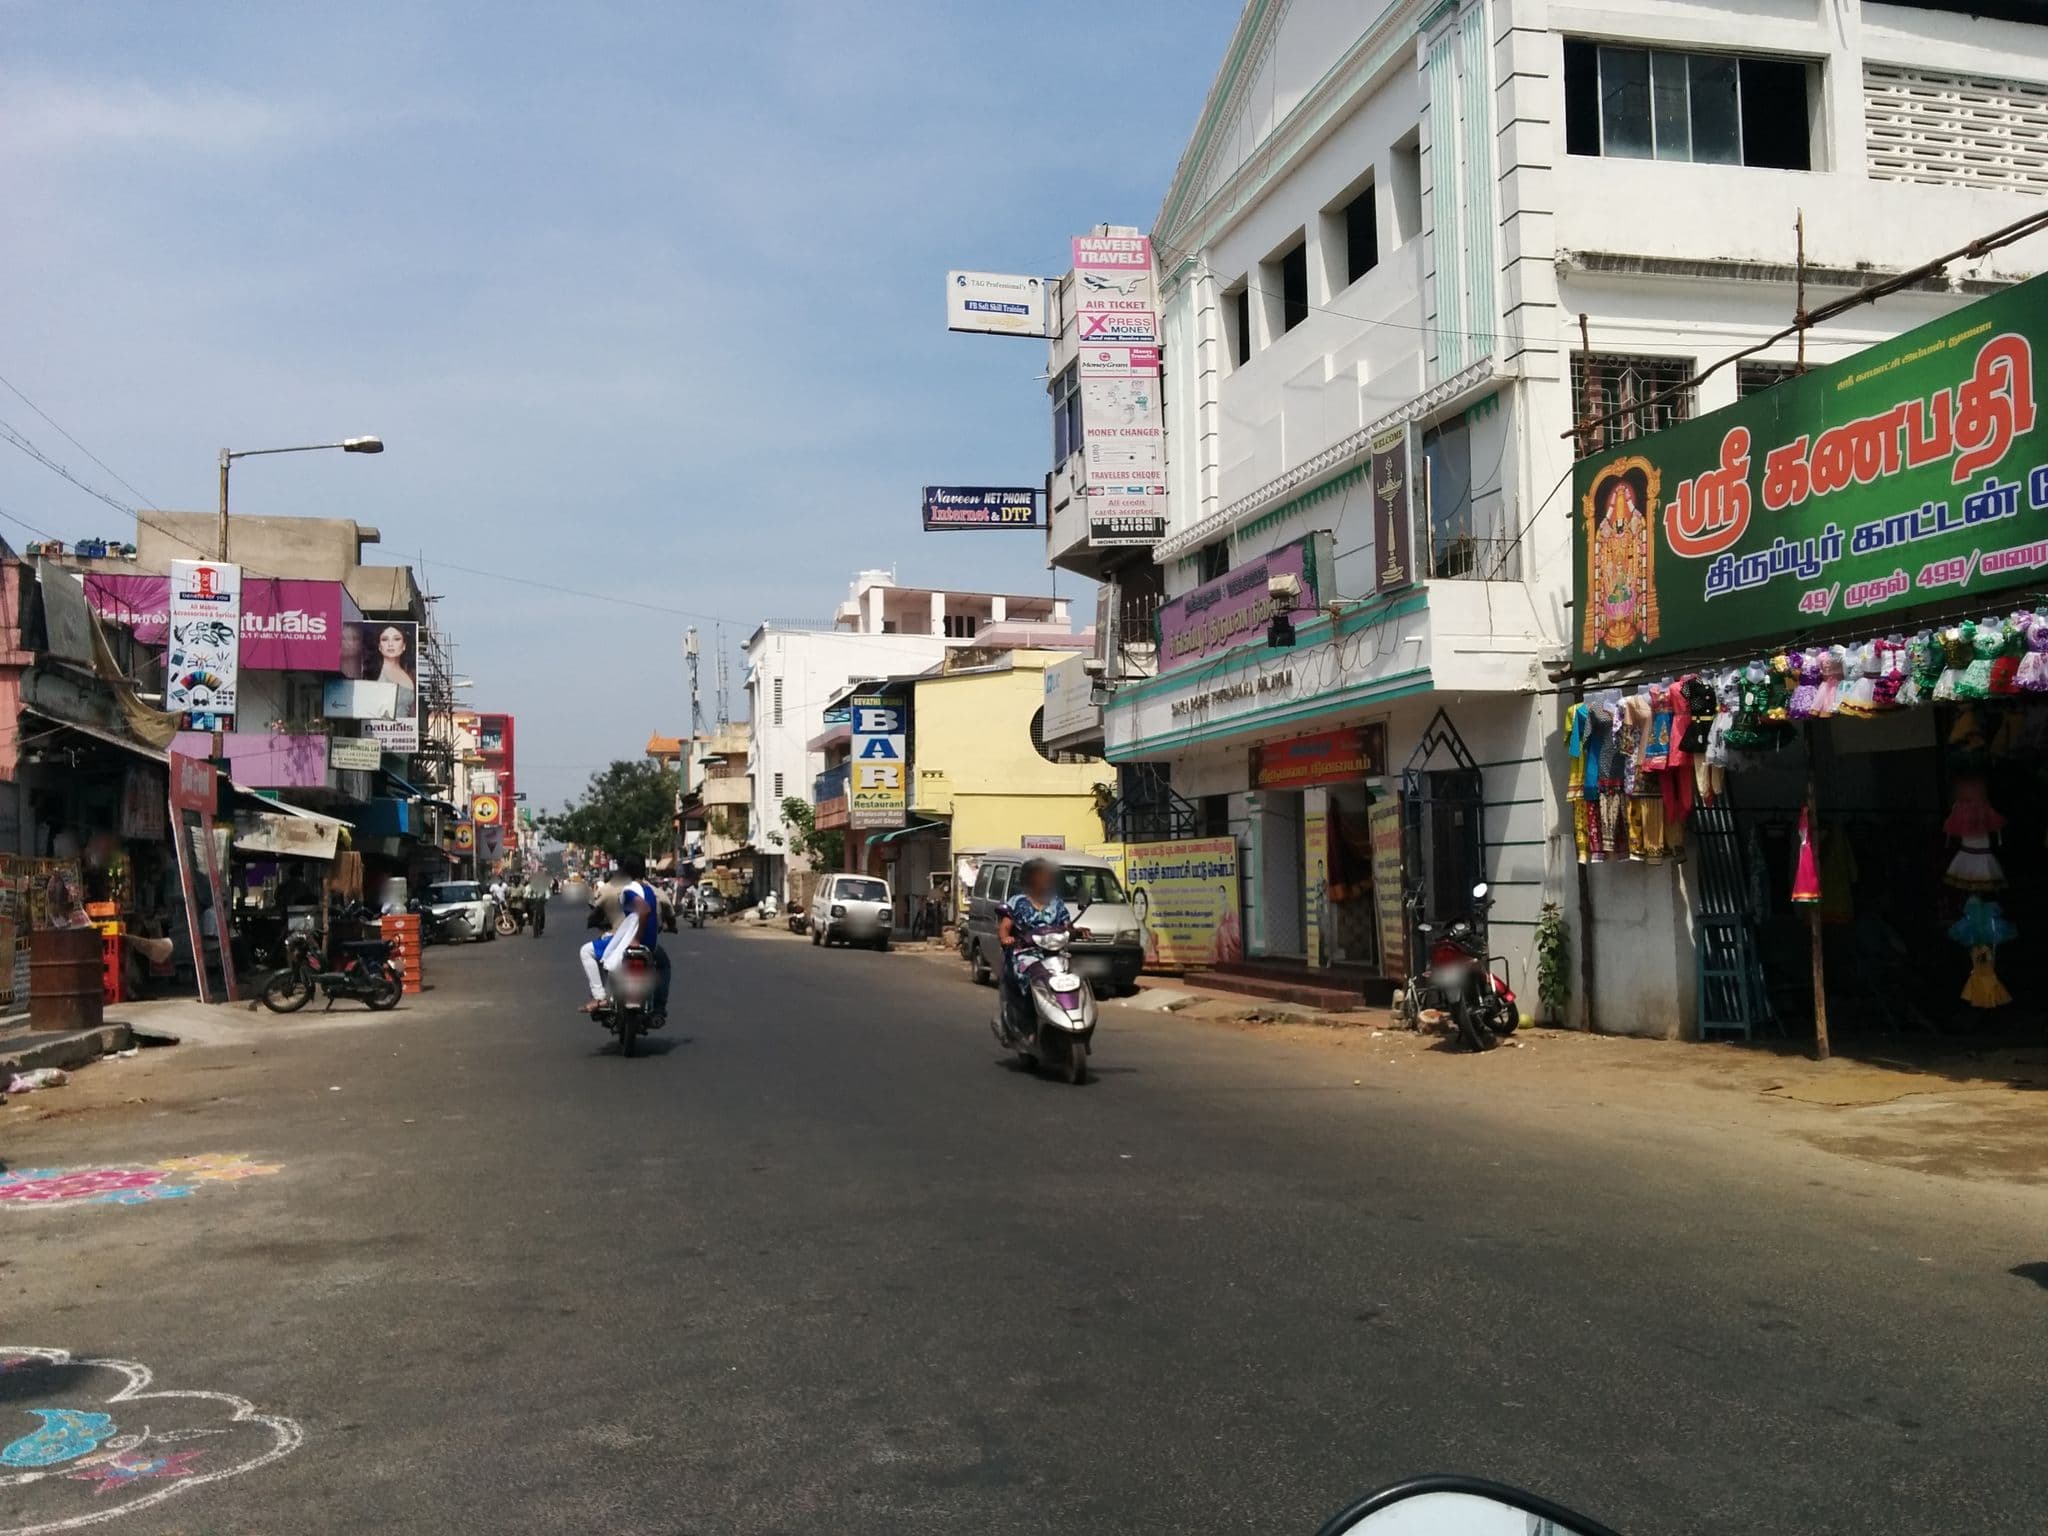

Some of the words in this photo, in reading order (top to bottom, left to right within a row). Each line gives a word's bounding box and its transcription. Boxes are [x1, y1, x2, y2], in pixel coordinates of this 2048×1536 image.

[1080, 239, 1143, 251] NAVEEN
[1079, 252, 1145, 264] TRAVELS
[1003, 305, 1026, 314] Training
[1086, 301, 1104, 309] AIR
[1108, 301, 1146, 309] TICKET
[1085, 314, 1151, 336] XPRESS
[1762, 333, 2037, 511] கணபதி
[1088, 428, 1118, 436] MONEY
[1120, 428, 1159, 436] CHANGER
[1373, 429, 1403, 449] WELCOME
[1091, 471, 1130, 479] TRAVELERS
[1132, 471, 1160, 479] CHEQUE
[929, 488, 981, 504] Naveen
[984, 492, 1003, 504] NET
[1003, 492, 1031, 504] PHONE
[930, 506, 990, 521] Internet
[991, 512, 1000, 521] &
[1000, 507, 1032, 521] DTP
[1704, 522, 1846, 602] திருப்பூர்
[1851, 476, 2021, 557] காட்டன்
[1844, 568, 1910, 609] முதல்
[1916, 548, 1980, 588] 499/
[859, 709, 900, 789] BAR
[854, 801, 904, 809] Restaurant
